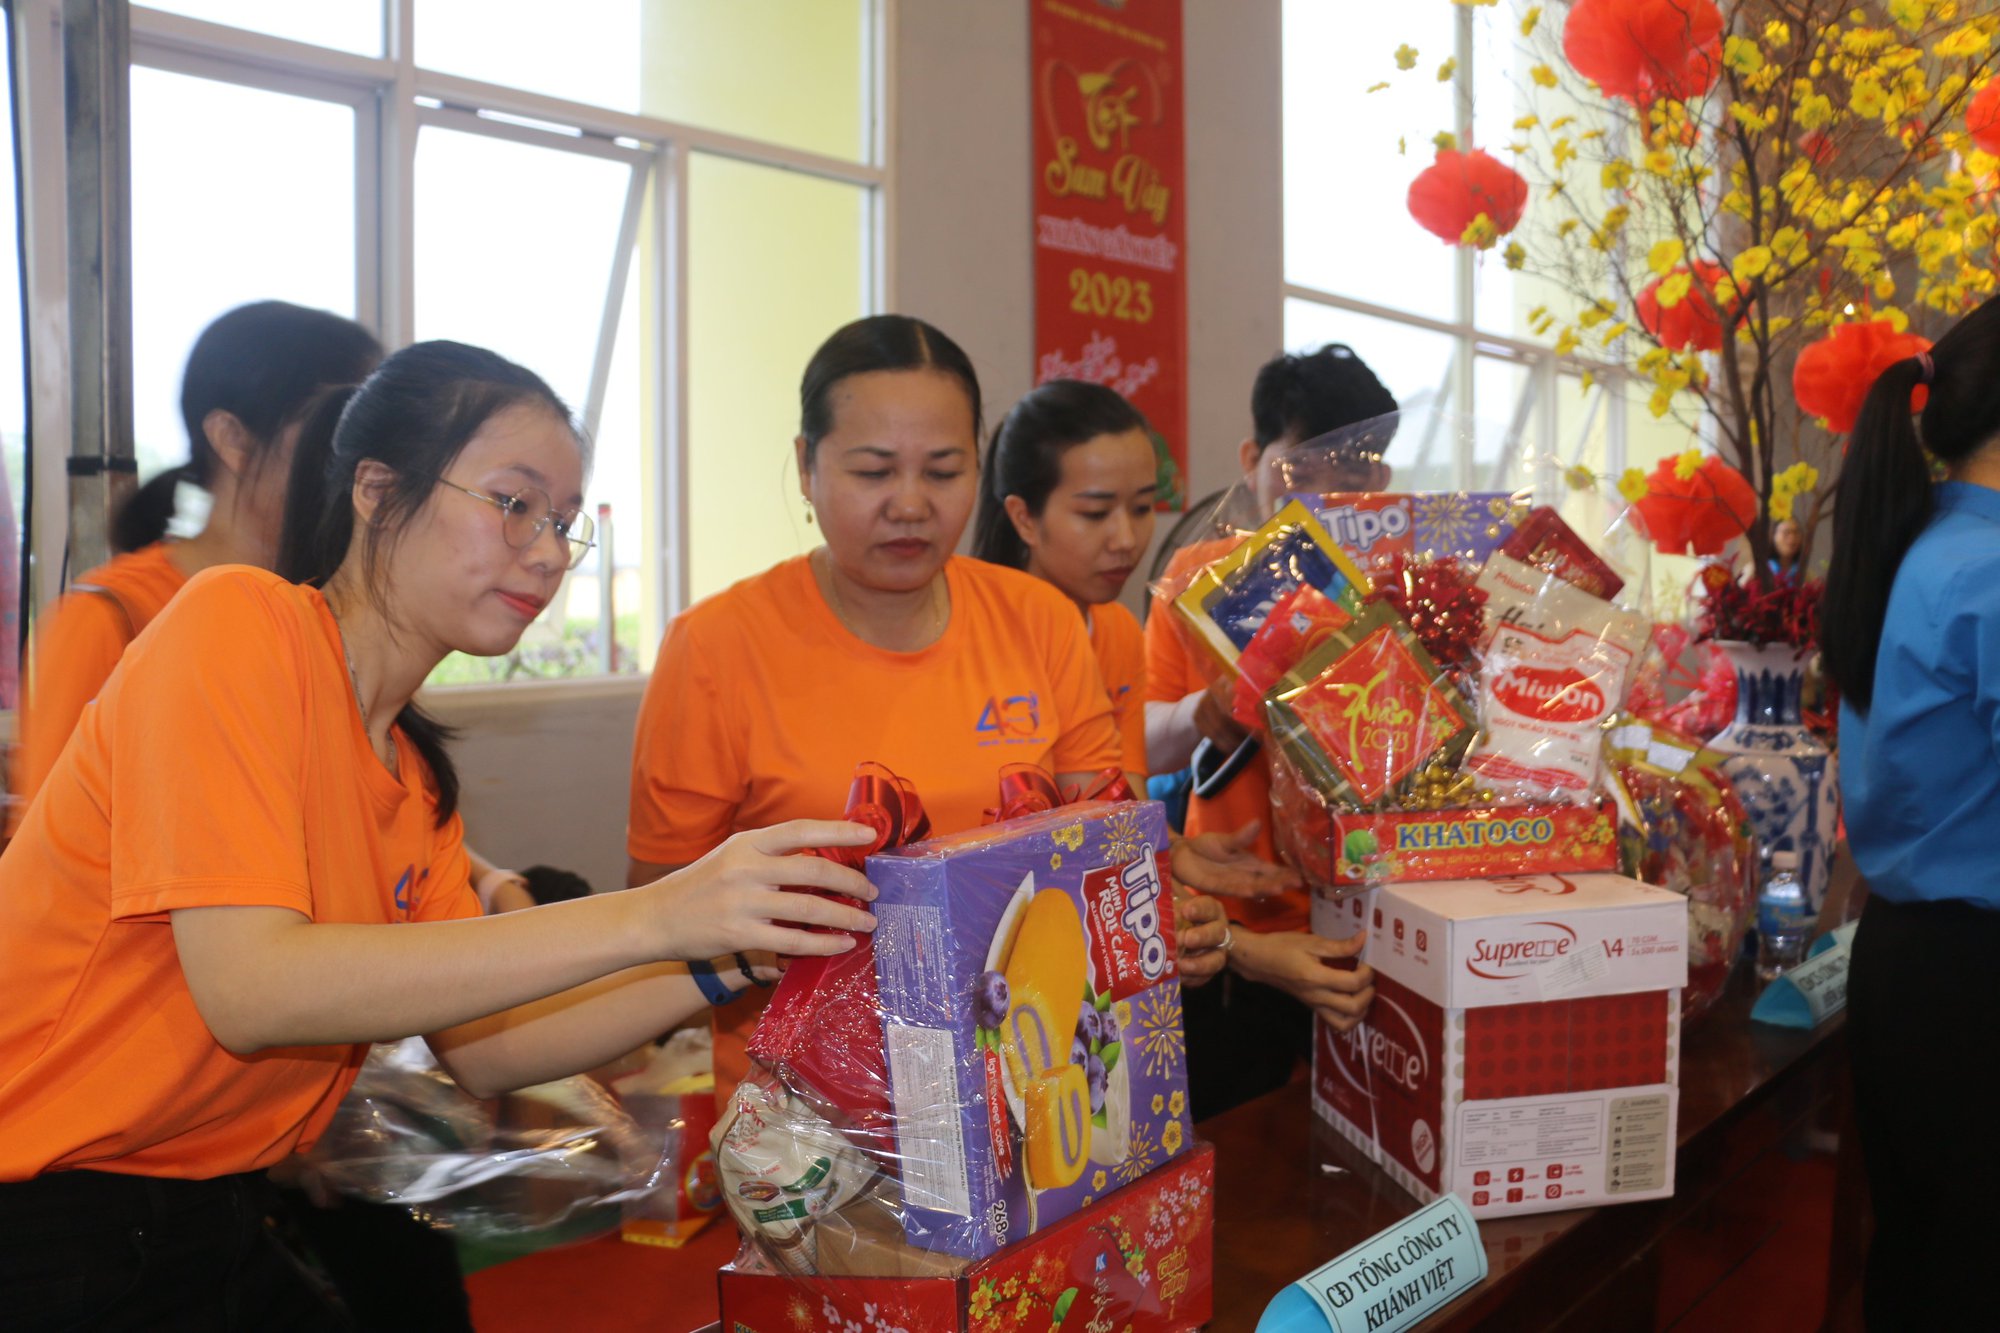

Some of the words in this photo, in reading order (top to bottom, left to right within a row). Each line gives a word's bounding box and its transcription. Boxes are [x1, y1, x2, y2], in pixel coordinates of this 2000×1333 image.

[1069, 267, 1153, 324] 2023
[1320, 505, 1410, 552] Tipo
[1495, 669, 1600, 713] Miwon
[1361, 726, 1409, 752] 2023
[1396, 819, 1554, 851] KHATOCO
[1105, 875, 1123, 913] MINI
[1121, 842, 1166, 980] Tipo
[1098, 887, 1119, 934] ROLL
[1111, 932, 1129, 981] CAKE
[1472, 937, 1570, 967] Supreme
[1103, 952, 1114, 988] YOGURT
[994, 1128, 1005, 1156] cake
[992, 1200, 1009, 1236] 268
[1326, 1281, 1354, 1308] CĐ
[1348, 1252, 1402, 1293] TỔNG
[1397, 1227, 1443, 1266] CÔNG
[1437, 1214, 1462, 1241] TY
[1364, 1279, 1422, 1333] KHÁNH
[1420, 1257, 1455, 1294] VIỆT
